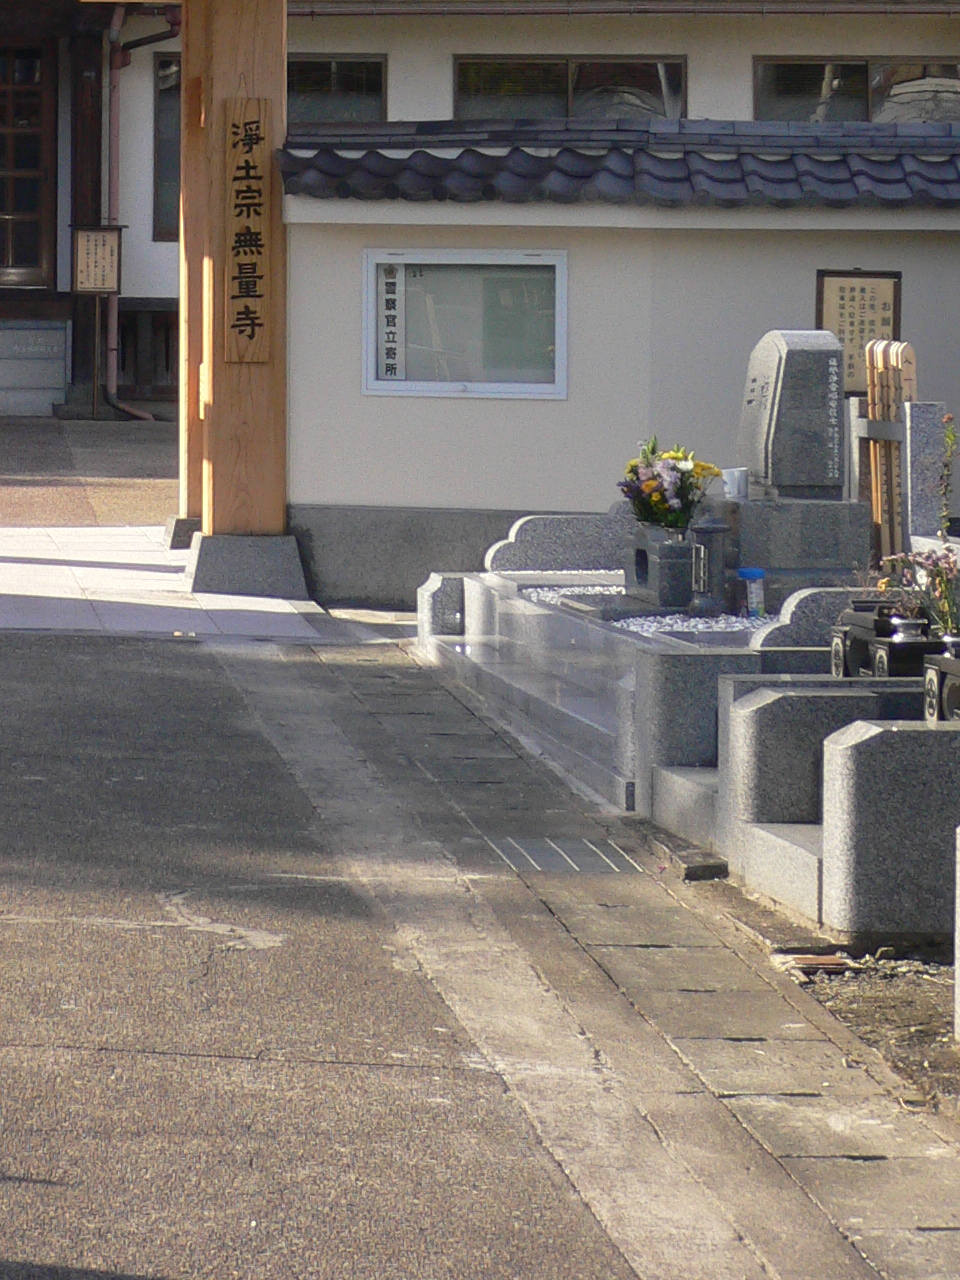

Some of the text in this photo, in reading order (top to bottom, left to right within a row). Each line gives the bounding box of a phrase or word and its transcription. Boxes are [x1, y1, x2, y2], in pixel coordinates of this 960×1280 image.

[384, 281, 398, 377] 警察官立寄所
